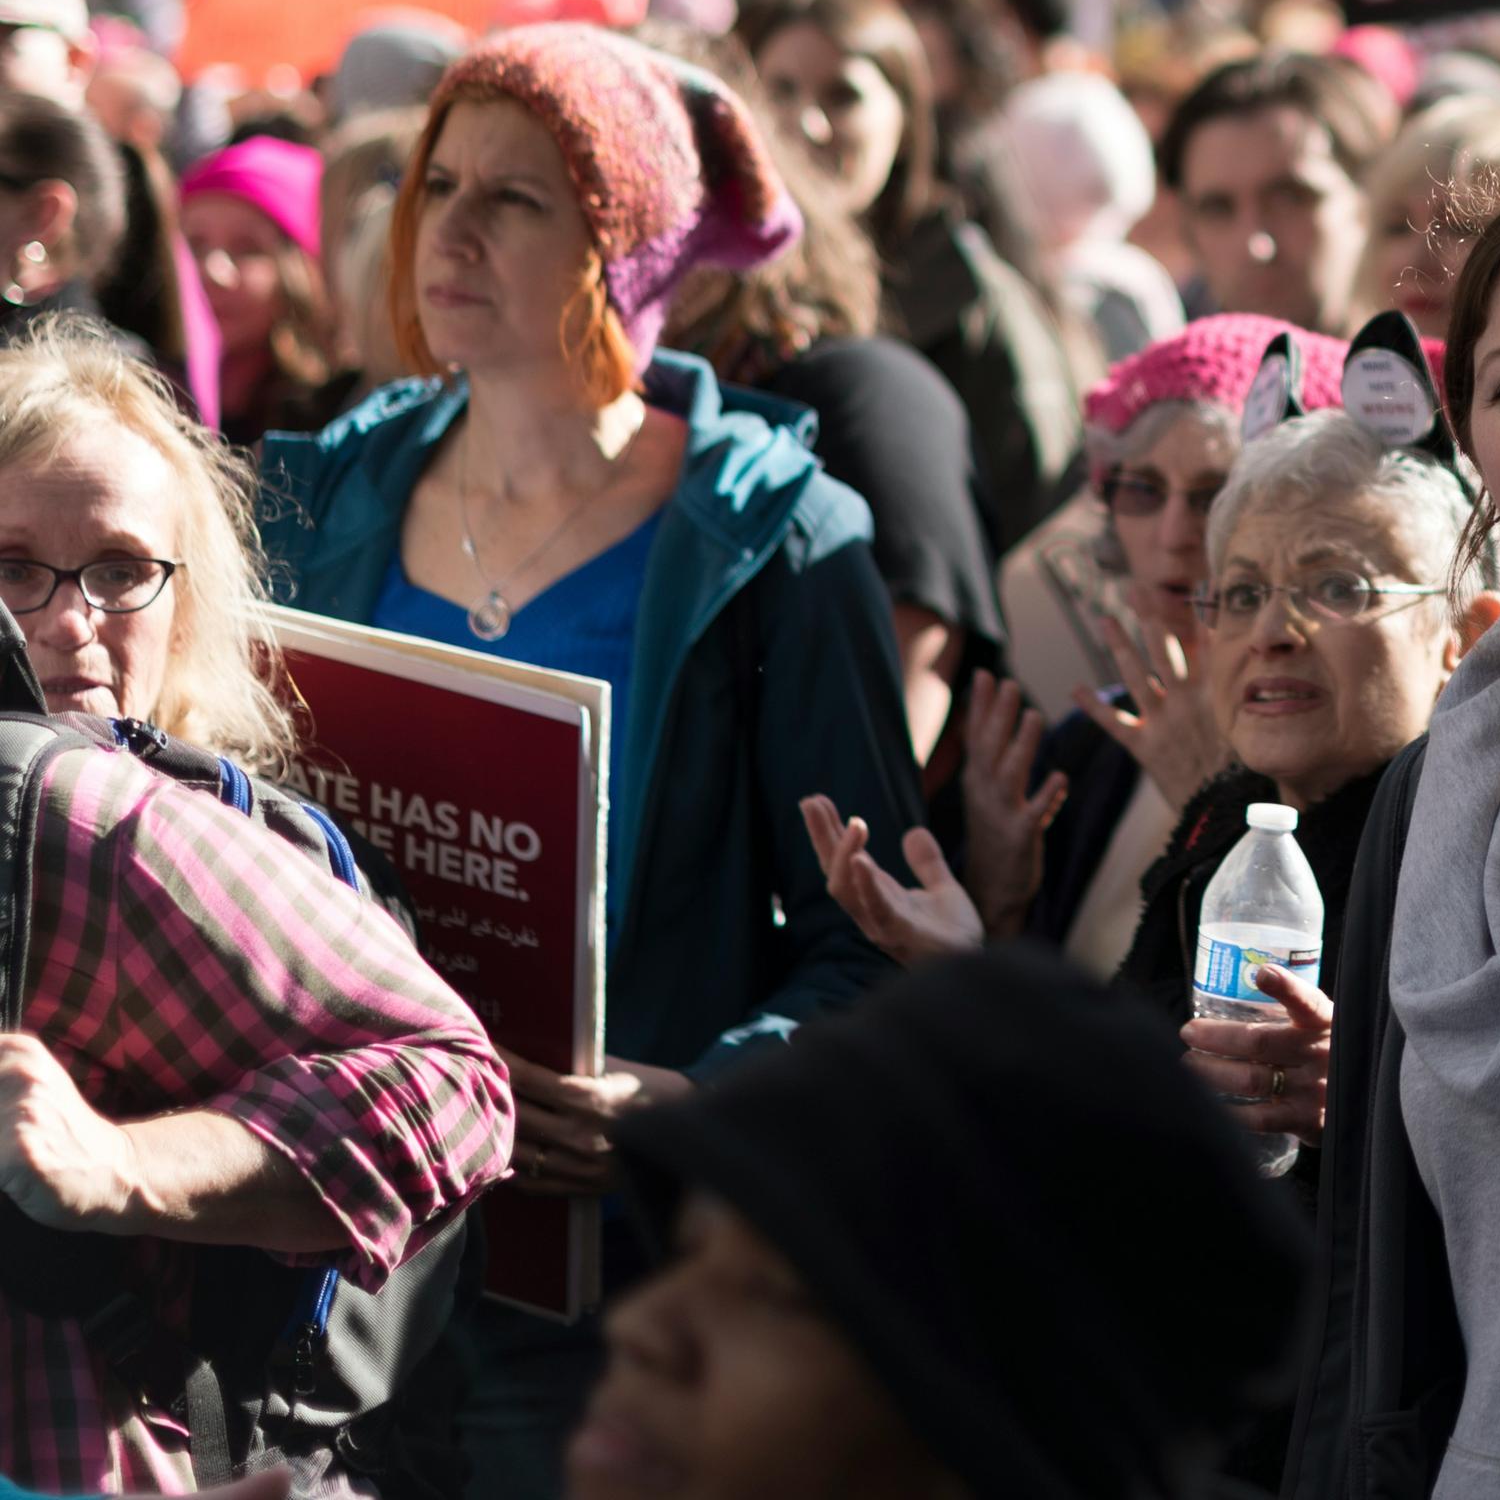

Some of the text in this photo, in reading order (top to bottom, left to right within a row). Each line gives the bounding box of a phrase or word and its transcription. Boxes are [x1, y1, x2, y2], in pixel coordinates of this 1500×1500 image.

[370, 781, 461, 841] HAS
[470, 810, 543, 863] NO
[405, 833, 530, 902] HERE.
